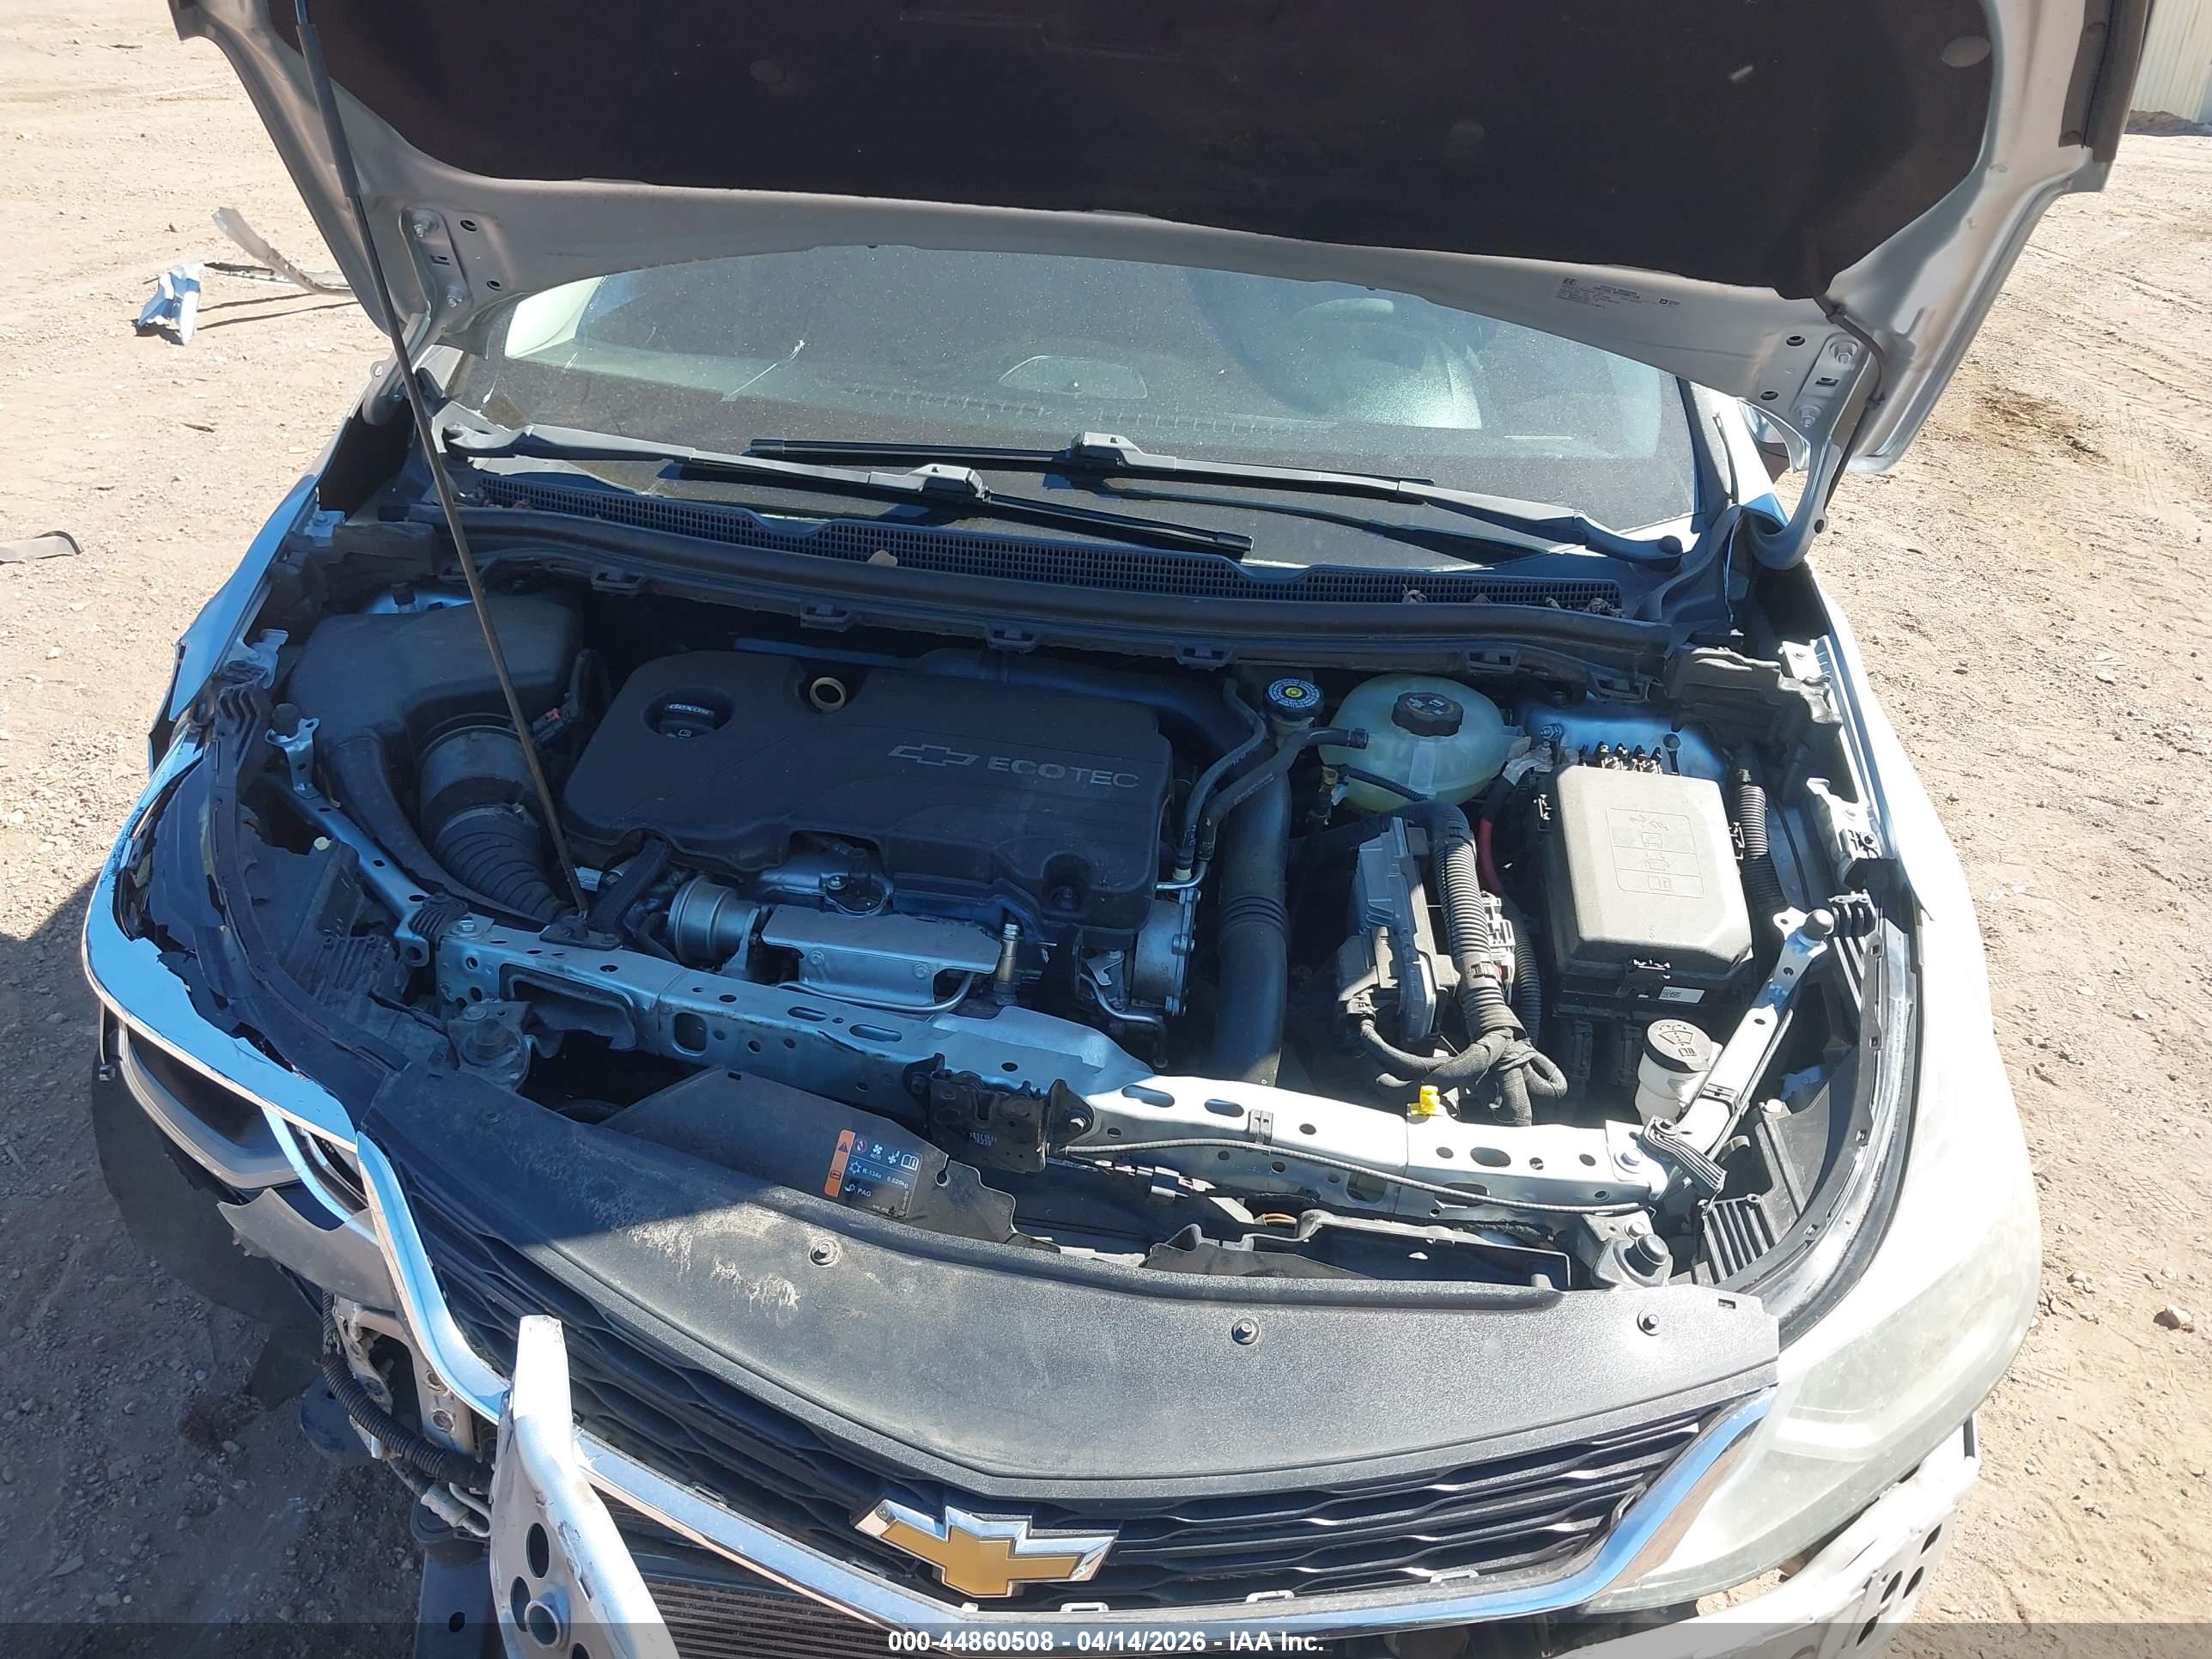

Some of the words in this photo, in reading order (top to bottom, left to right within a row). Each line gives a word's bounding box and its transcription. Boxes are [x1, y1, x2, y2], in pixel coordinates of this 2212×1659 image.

[668, 702, 710, 715] dexos
[988, 755, 1139, 788] ECOTEC
[857, 1188, 872, 1197] PAG
